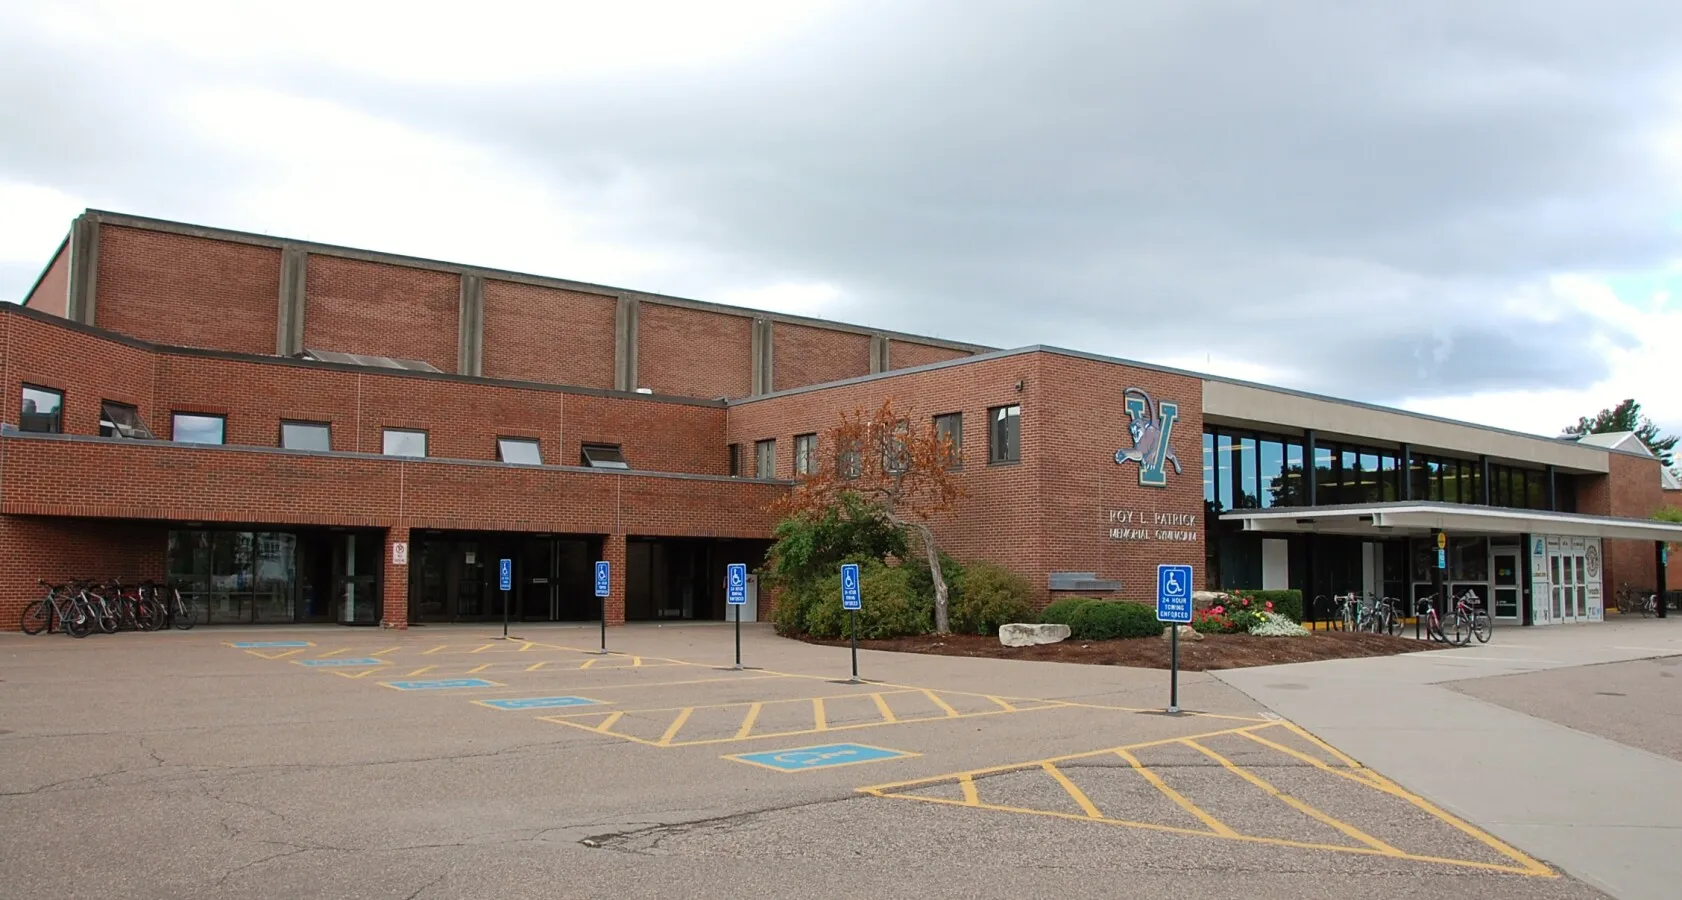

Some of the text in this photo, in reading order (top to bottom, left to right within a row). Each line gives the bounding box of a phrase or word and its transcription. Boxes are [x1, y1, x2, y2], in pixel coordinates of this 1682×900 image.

[1109, 509, 1133, 523] ROY
[1154, 512, 1196, 526] PATRICK
[1109, 528, 1197, 541] MEMORIAL GYMNASIUM
